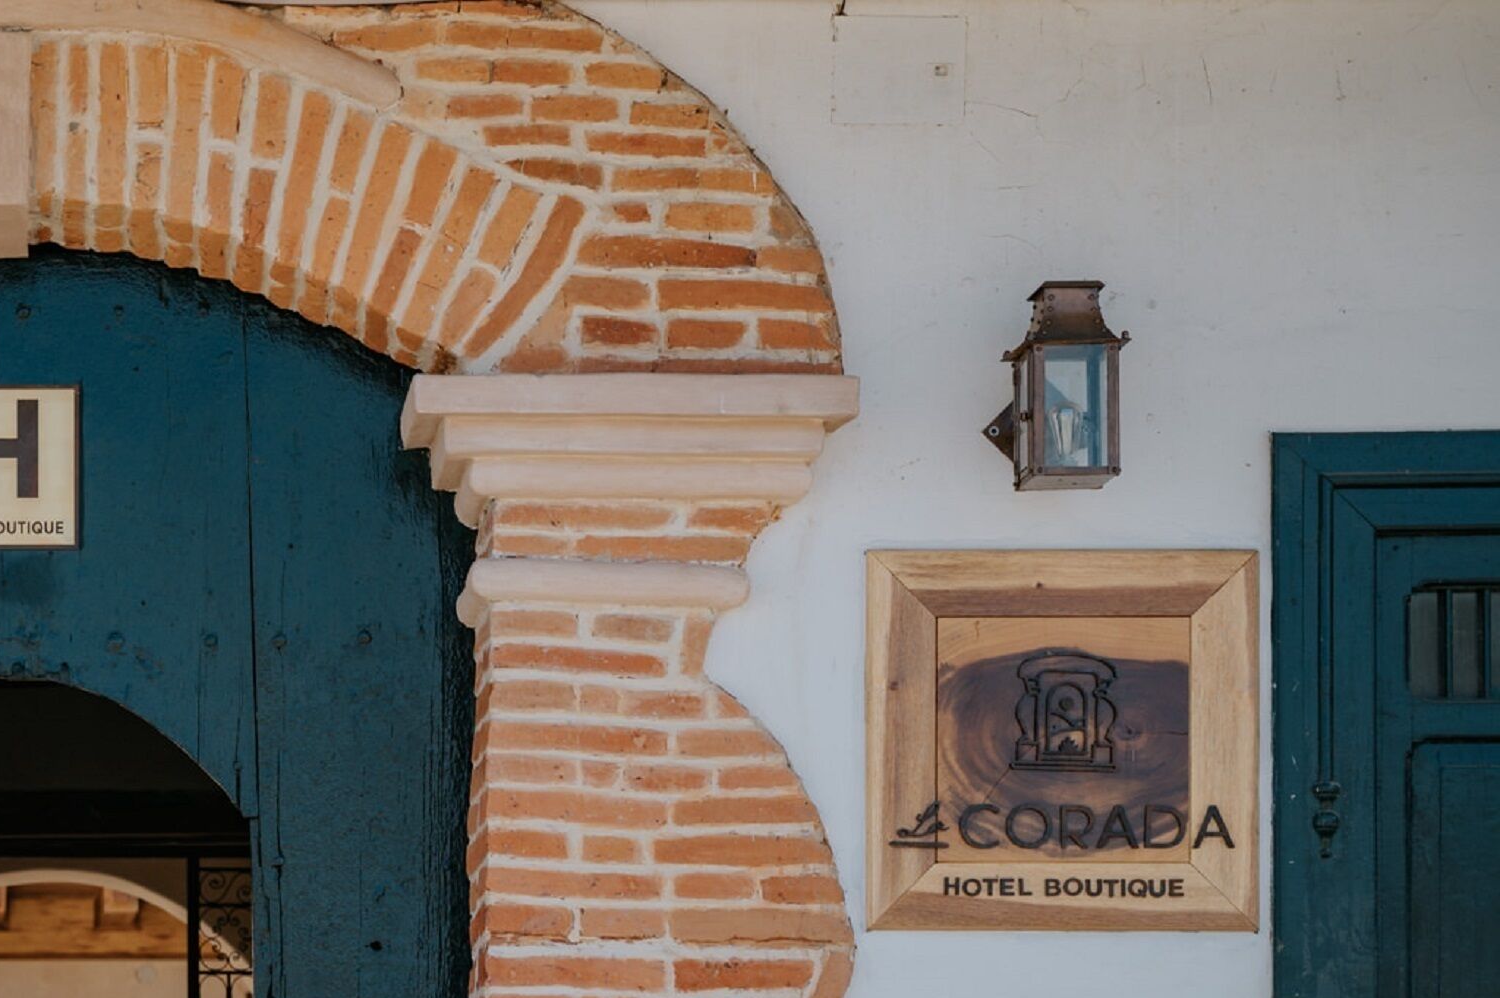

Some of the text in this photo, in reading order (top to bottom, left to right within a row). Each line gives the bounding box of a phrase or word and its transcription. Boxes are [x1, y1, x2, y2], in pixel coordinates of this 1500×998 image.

[958, 803, 1236, 849] CORADA
[943, 876, 1185, 898] HOTEL BOUTIQUE
